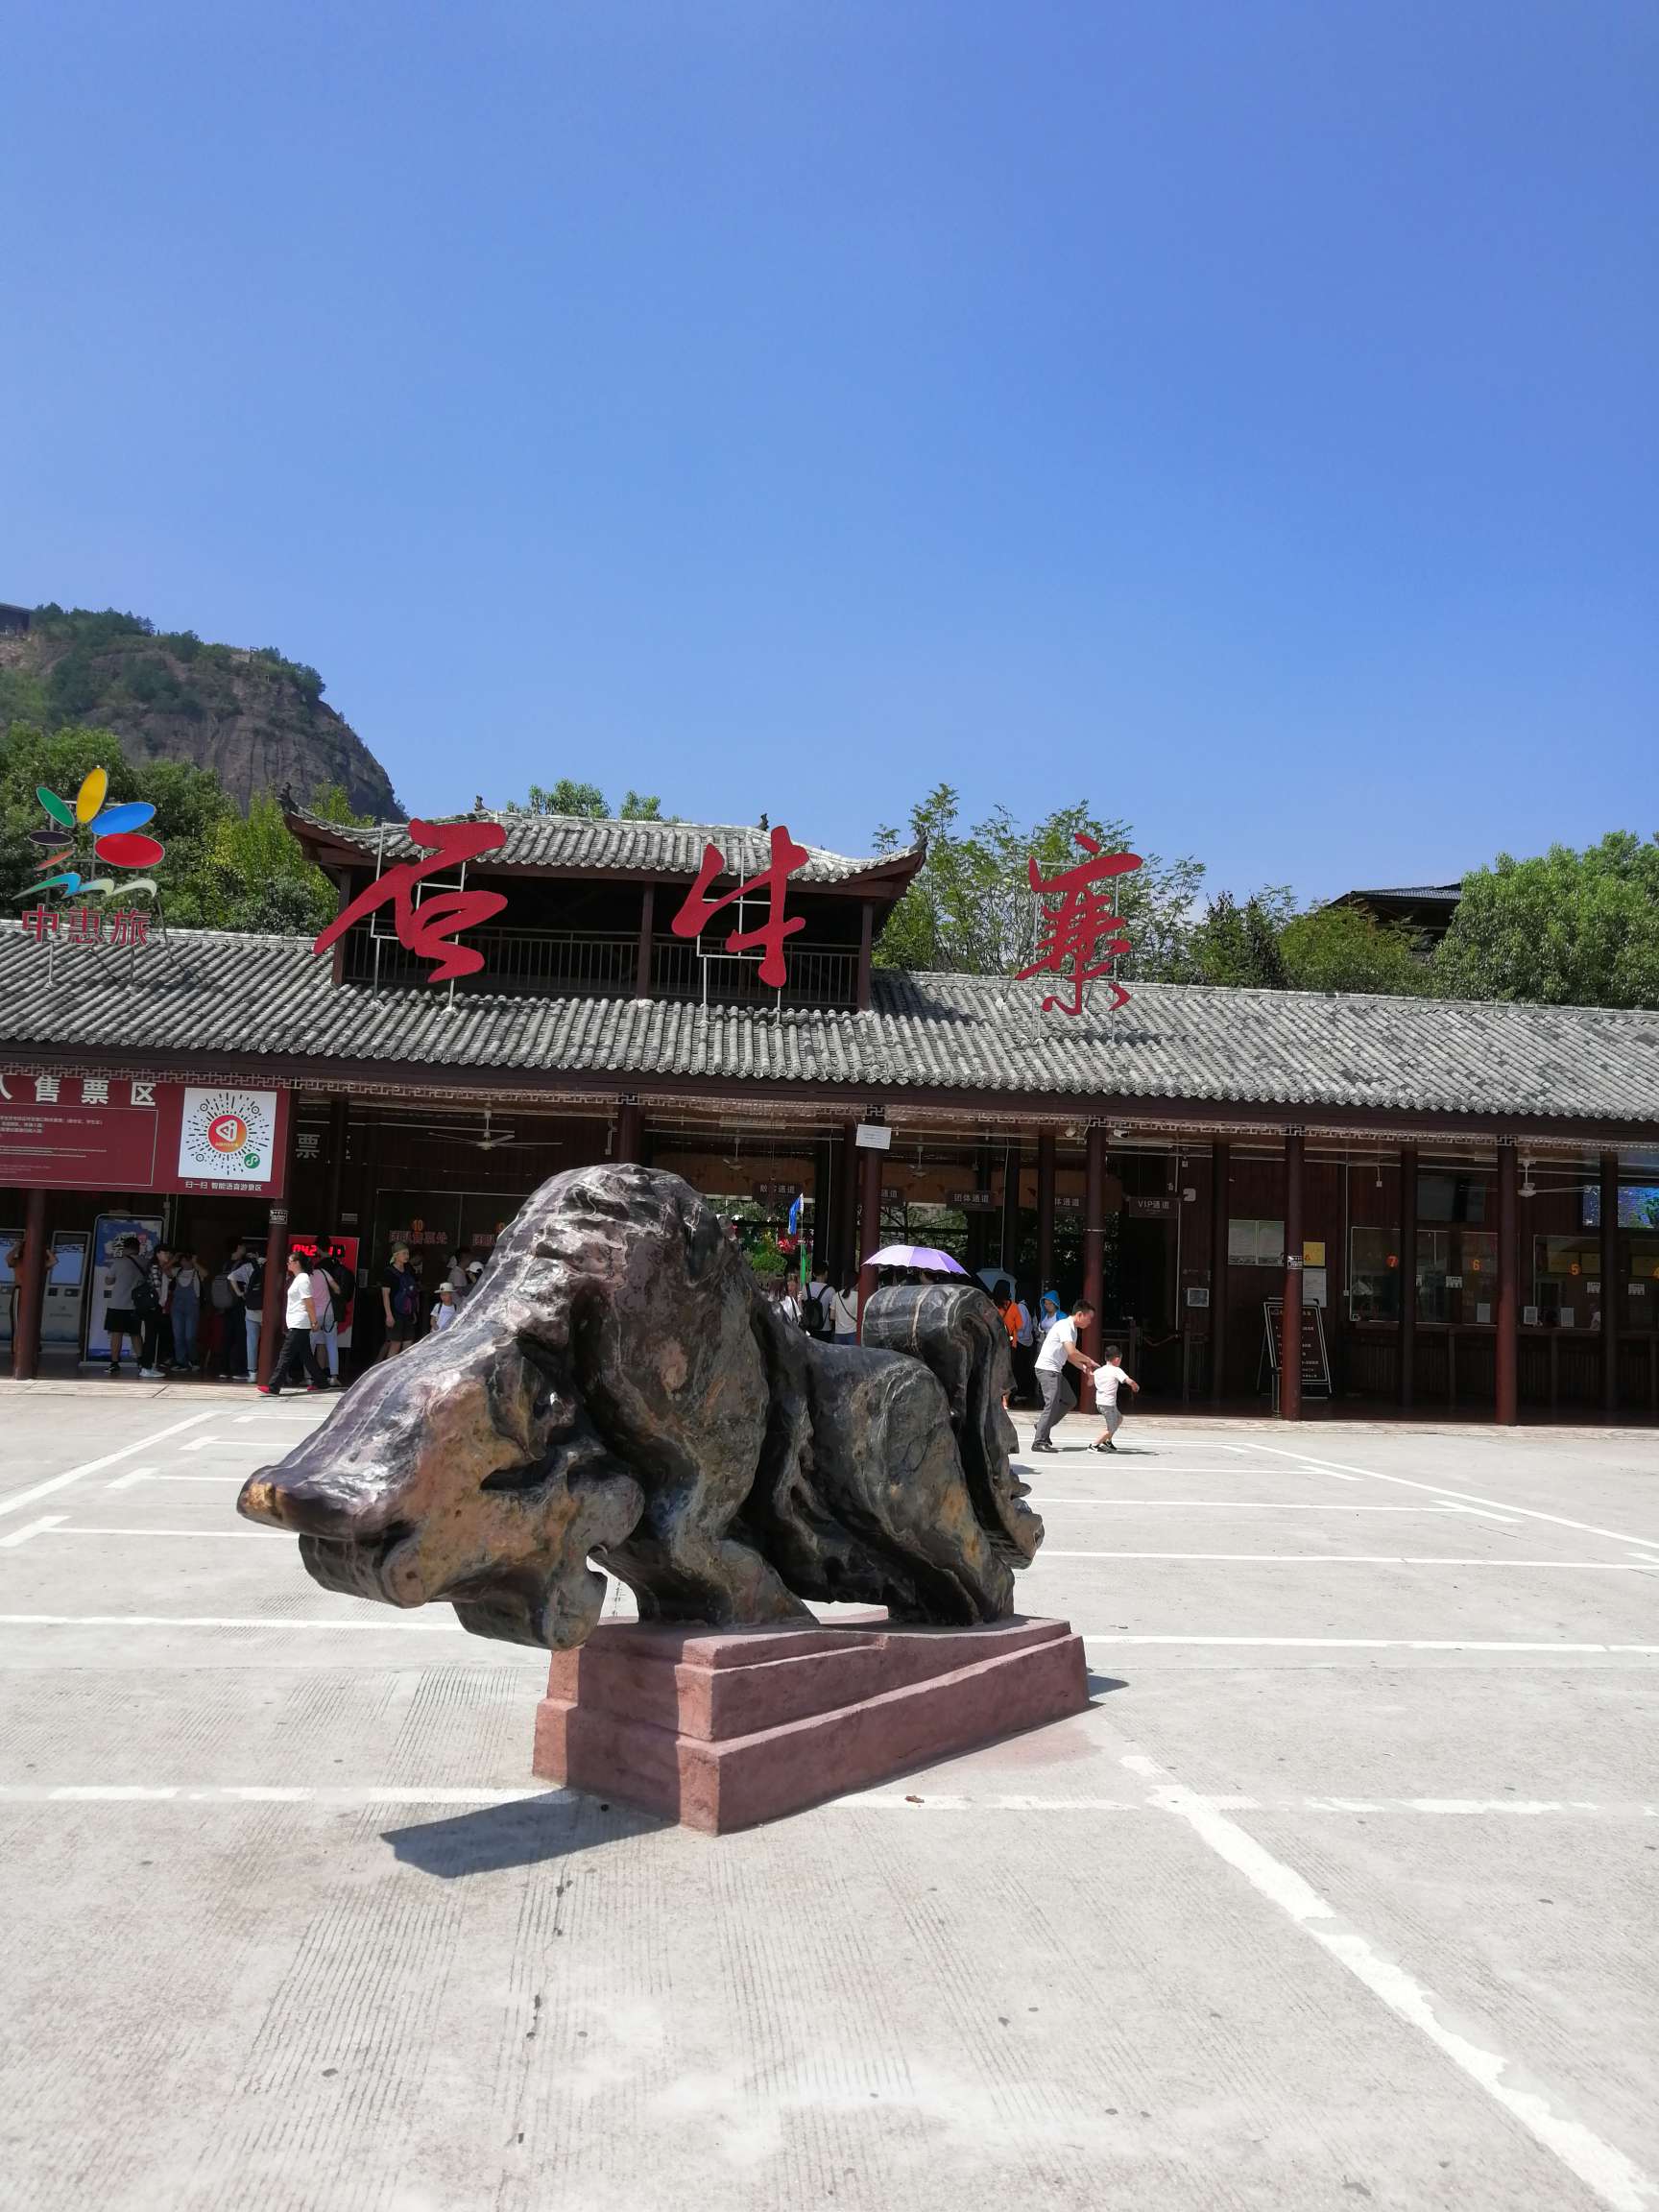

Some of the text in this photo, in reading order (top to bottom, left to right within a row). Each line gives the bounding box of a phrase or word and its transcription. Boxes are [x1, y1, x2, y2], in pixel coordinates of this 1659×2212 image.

[21, 903, 152, 947] 中惠旅
[185, 1181, 208, 1190] 扫一扫
[759, 1184, 795, 1193] 散通道
[1472, 1259, 1481, 1271] 6
